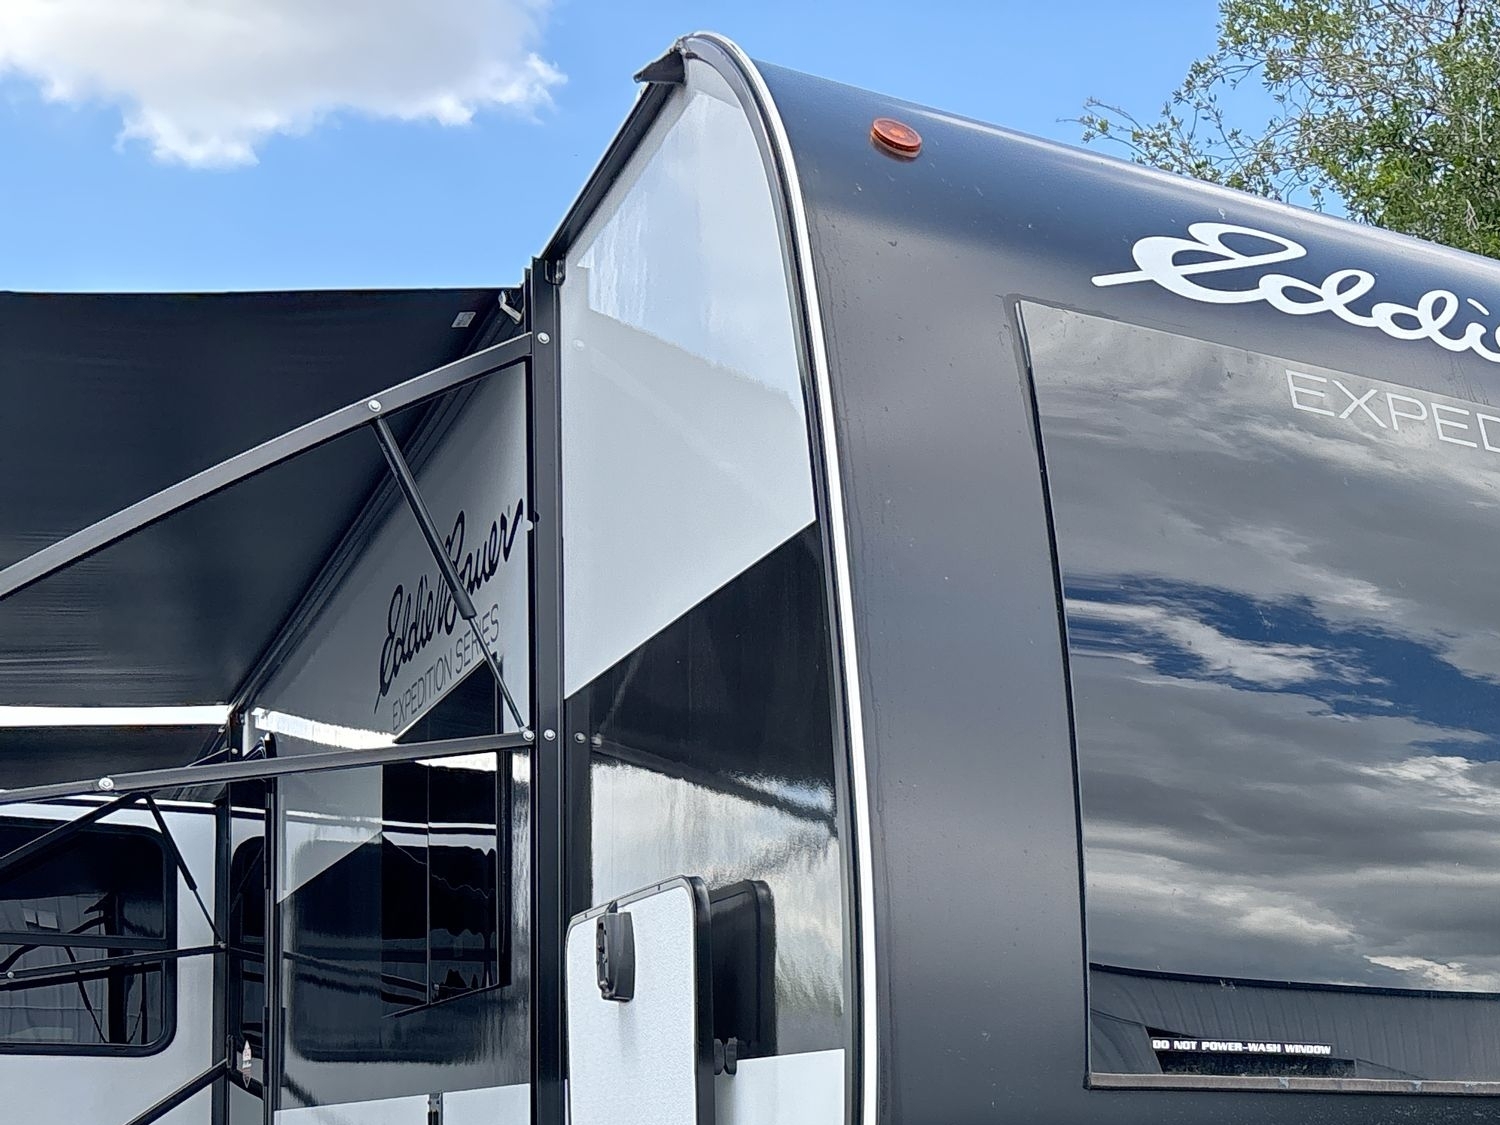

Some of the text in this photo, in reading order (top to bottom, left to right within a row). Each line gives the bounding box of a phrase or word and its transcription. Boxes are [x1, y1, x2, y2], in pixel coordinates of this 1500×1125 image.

[374, 573, 439, 714] Eddie
[392, 647, 453, 731] EXPEDITION
[1152, 1039, 1332, 1055] DO NOT POWER-WASH WINDOW
